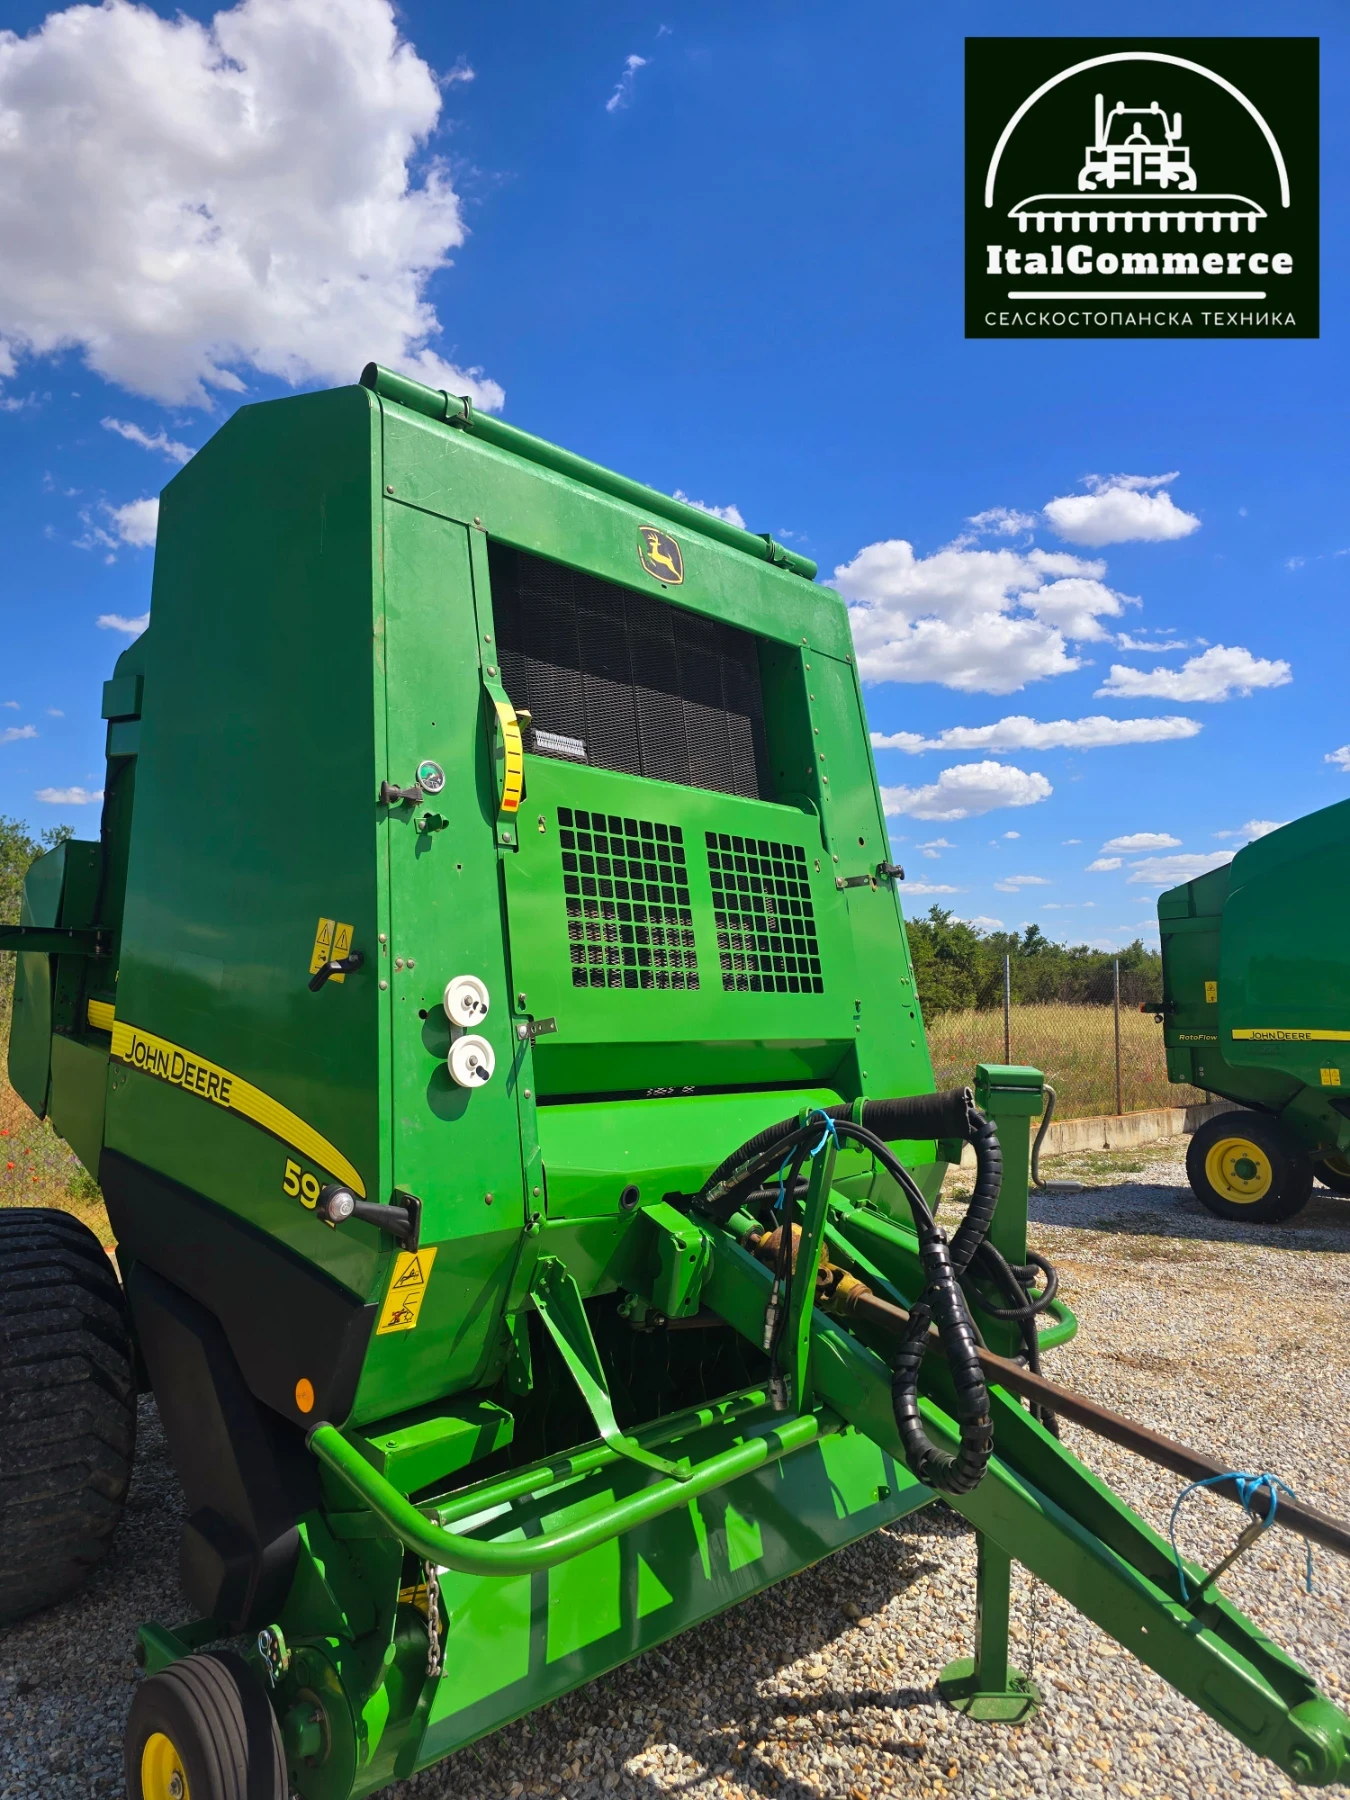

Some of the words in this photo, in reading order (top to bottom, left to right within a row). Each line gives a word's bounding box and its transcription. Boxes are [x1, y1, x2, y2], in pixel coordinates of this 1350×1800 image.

[1179, 1033, 1218, 1041] RotoFlow
[1250, 1031, 1276, 1040] JOHN
[1277, 1030, 1312, 1040] DEERE
[124, 1034, 169, 1074] JOHN
[170, 1051, 233, 1104] DEERE
[282, 1157, 337, 1230] 59
